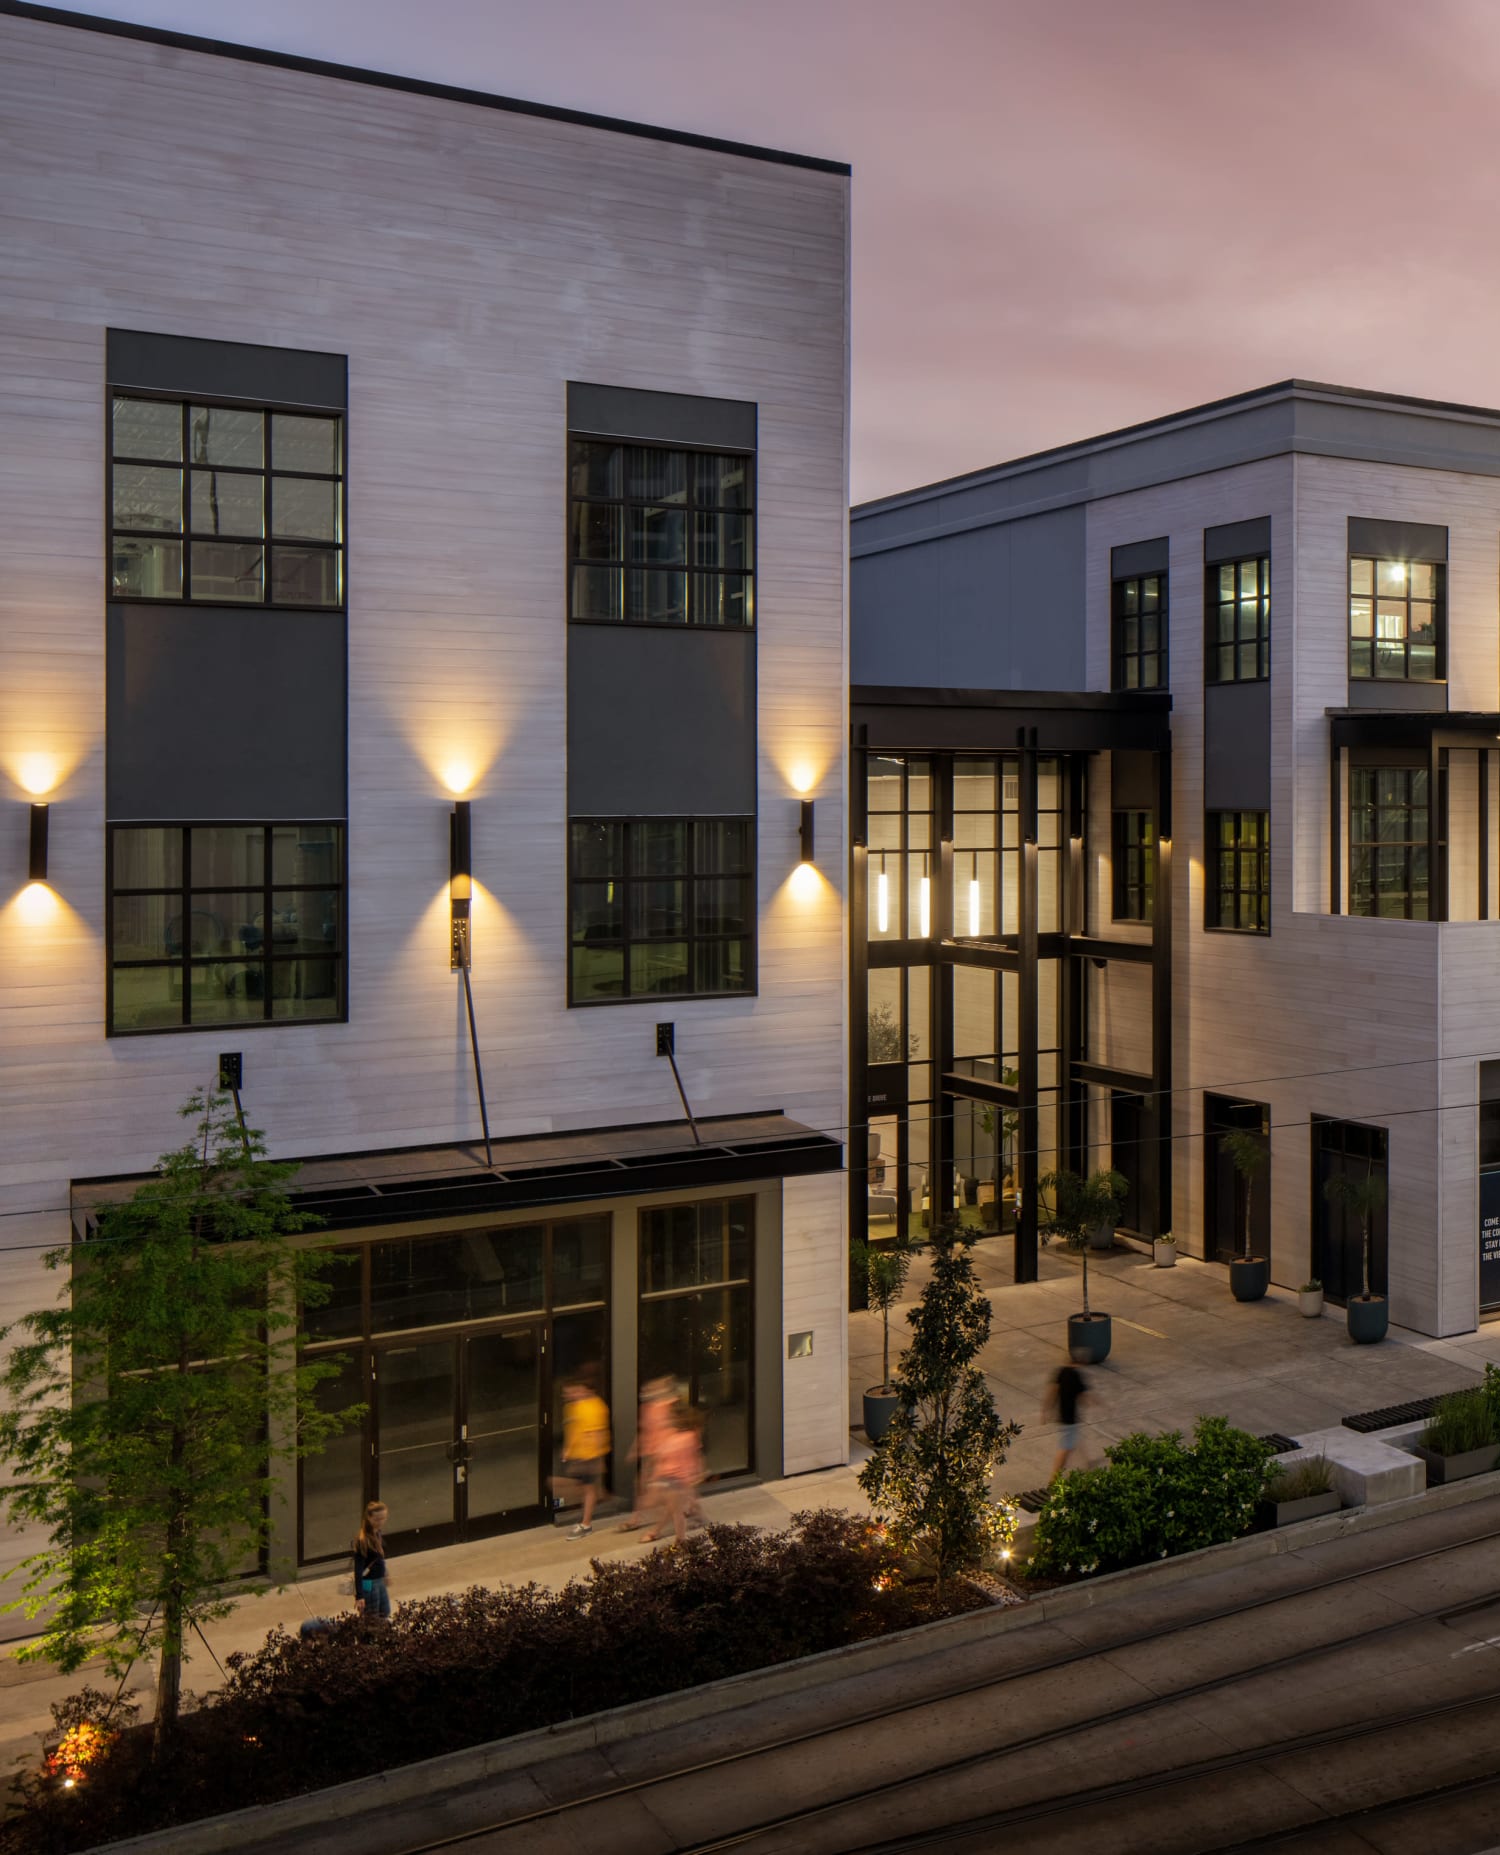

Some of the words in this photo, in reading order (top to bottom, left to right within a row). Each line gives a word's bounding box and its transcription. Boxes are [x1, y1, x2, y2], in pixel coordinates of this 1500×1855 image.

[1484, 1217, 1499, 1227] COME
[1482, 1230, 1491, 1239] THE
[1485, 1240, 1499, 1249] STAY
[1482, 1252, 1493, 1261] THE
